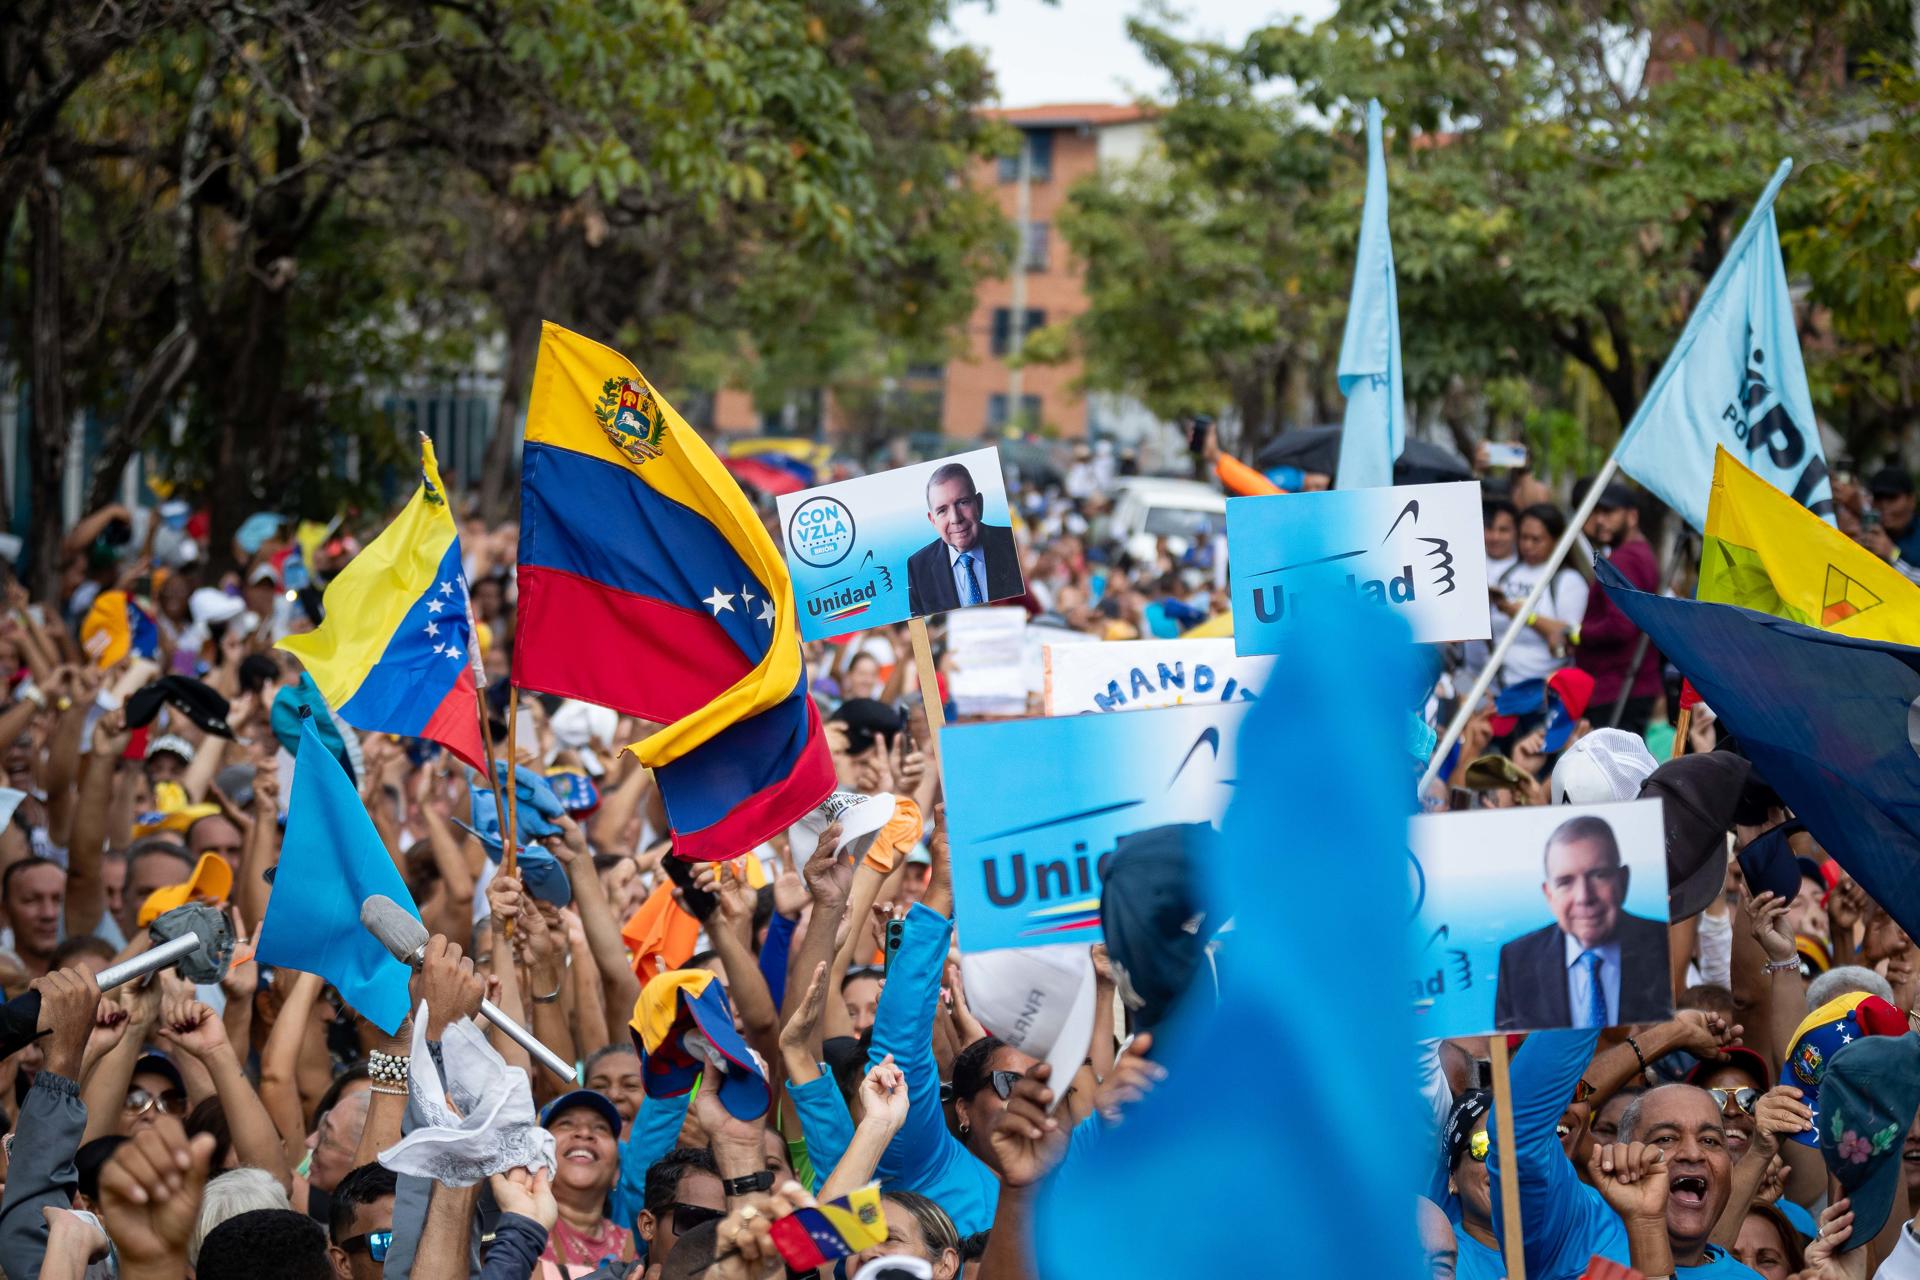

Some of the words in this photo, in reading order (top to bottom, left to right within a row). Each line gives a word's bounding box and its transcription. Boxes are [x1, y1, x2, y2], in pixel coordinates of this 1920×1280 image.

[797, 520, 847, 543] VZLA
[798, 504, 839, 527] CON
[807, 580, 877, 617] Unidad
[1080, 661, 1259, 712] MANDI
[984, 841, 1114, 909] Uni
